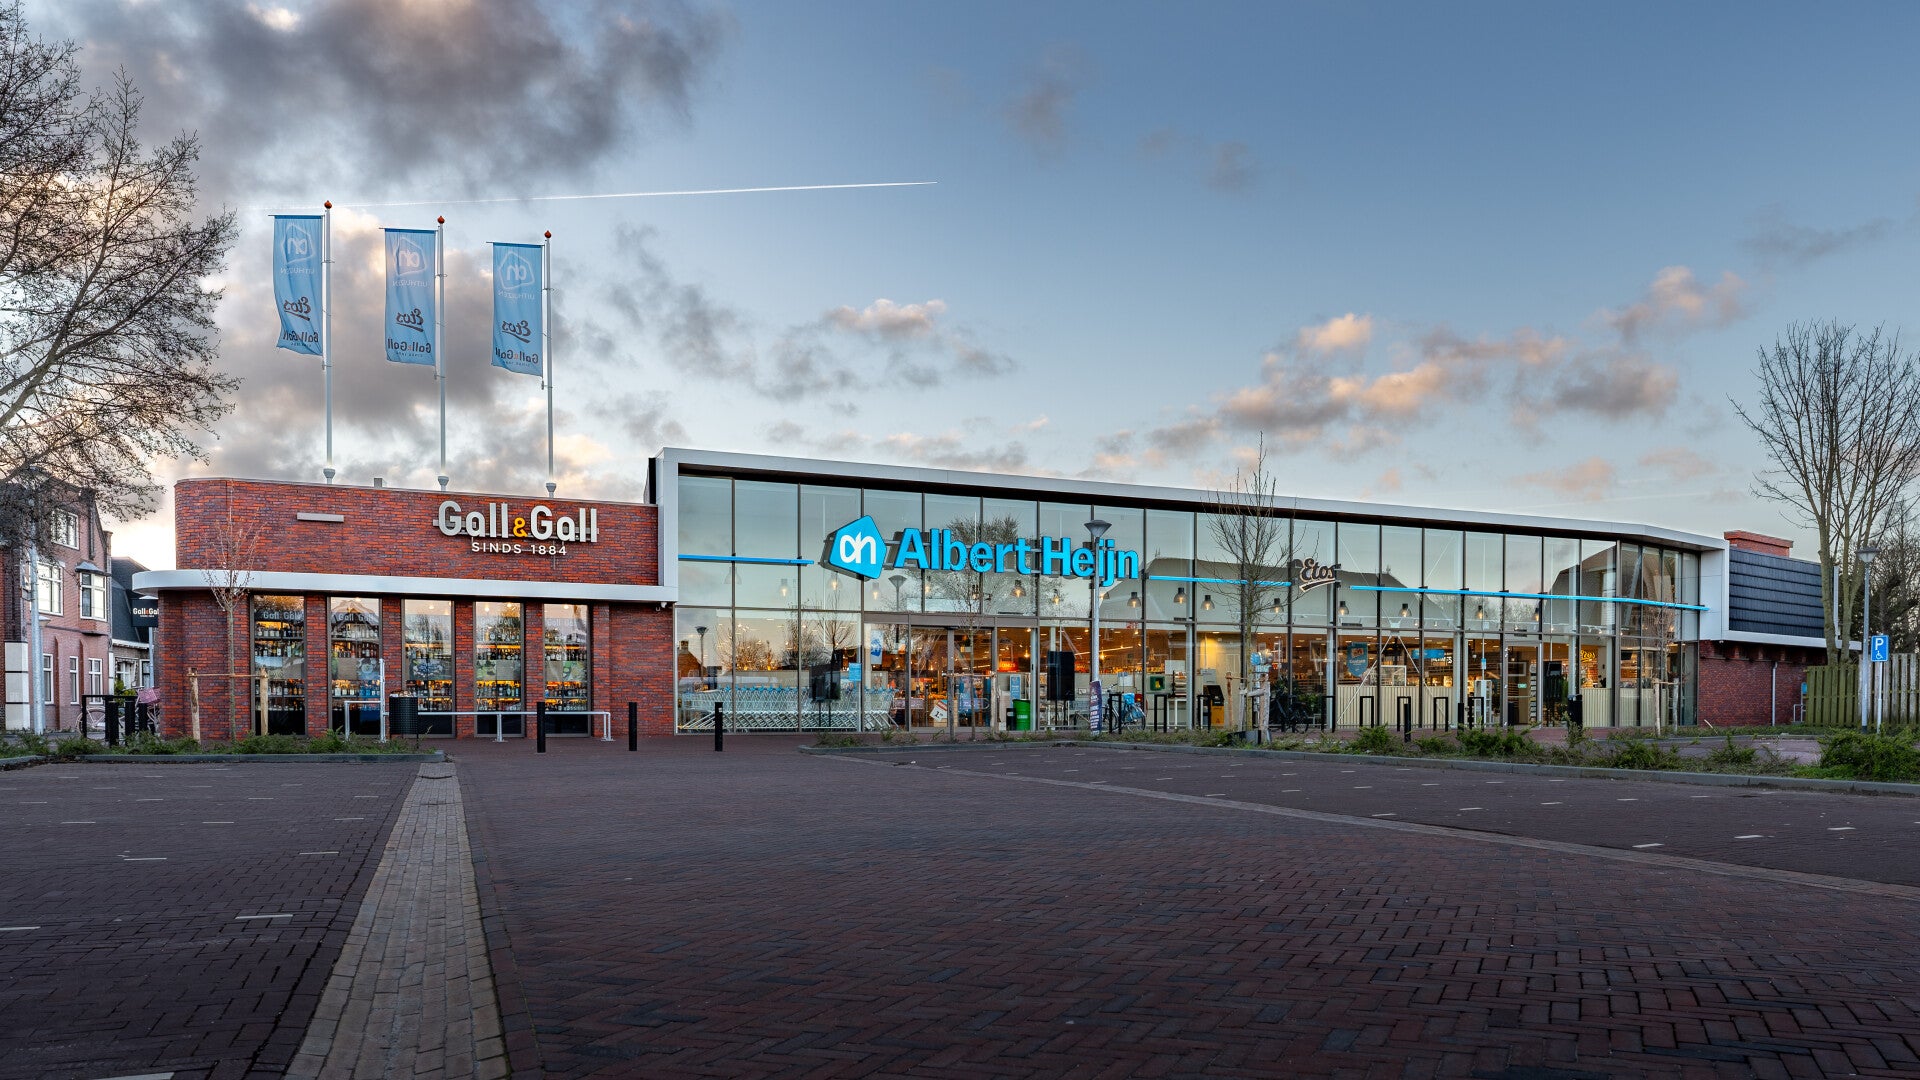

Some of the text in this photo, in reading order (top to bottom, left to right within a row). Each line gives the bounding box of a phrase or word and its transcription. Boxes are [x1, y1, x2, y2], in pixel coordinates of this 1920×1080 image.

[472, 542, 567, 555] SINDS 1884
[893, 528, 1139, 587] Albert Heijn
[1299, 556, 1340, 583] Etos
[1875, 638, 1884, 650] P
